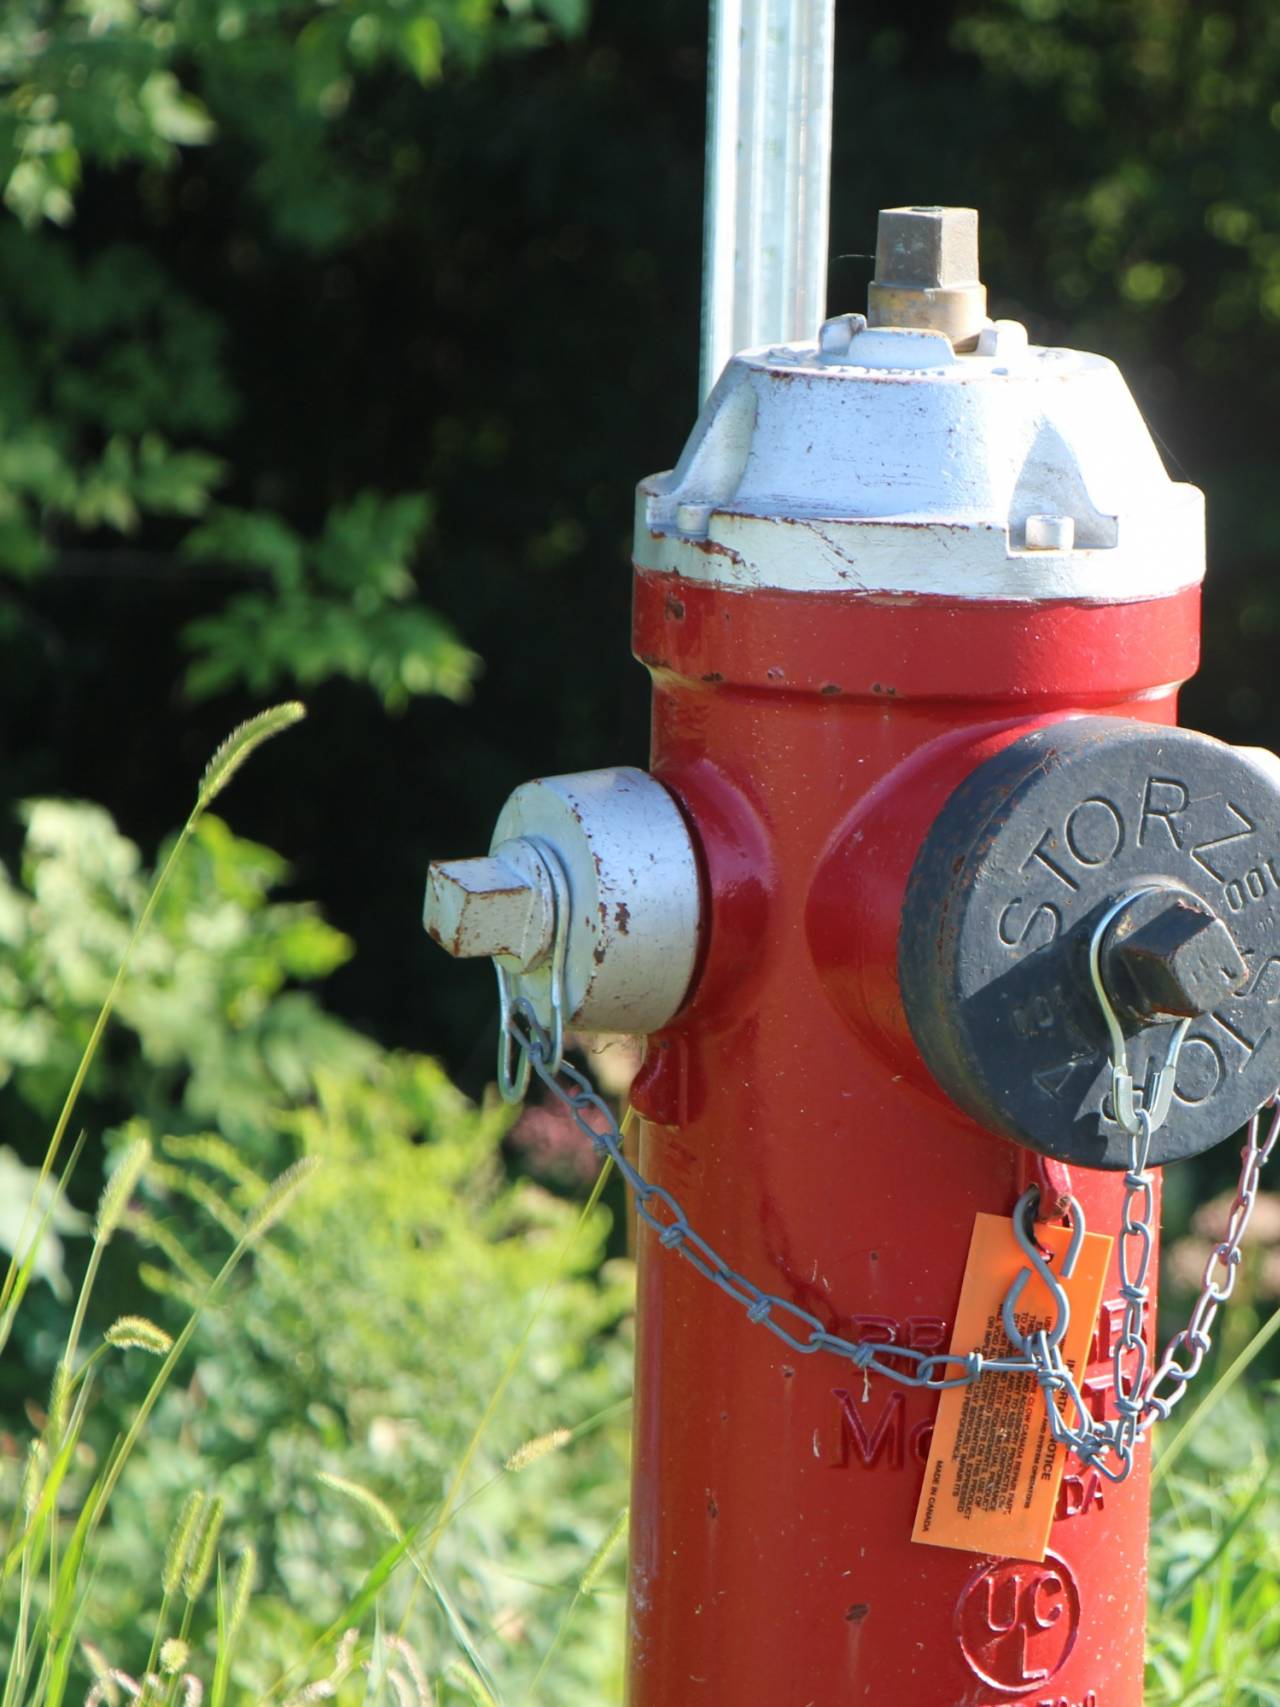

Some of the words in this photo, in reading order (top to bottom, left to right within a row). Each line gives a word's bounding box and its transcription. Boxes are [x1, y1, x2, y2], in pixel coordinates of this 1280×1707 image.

[998, 777, 1257, 948] STORZ
[1054, 1358, 1075, 1421] IMRTA
[1024, 1396, 1034, 1421] CLOW
[1016, 1423, 1029, 1458] CANADA
[1041, 1433, 1058, 1480] NOTICE
[933, 1459, 944, 1483] MADE
[930, 1486, 938, 1495] IN
[922, 1495, 936, 1531] CANADA
